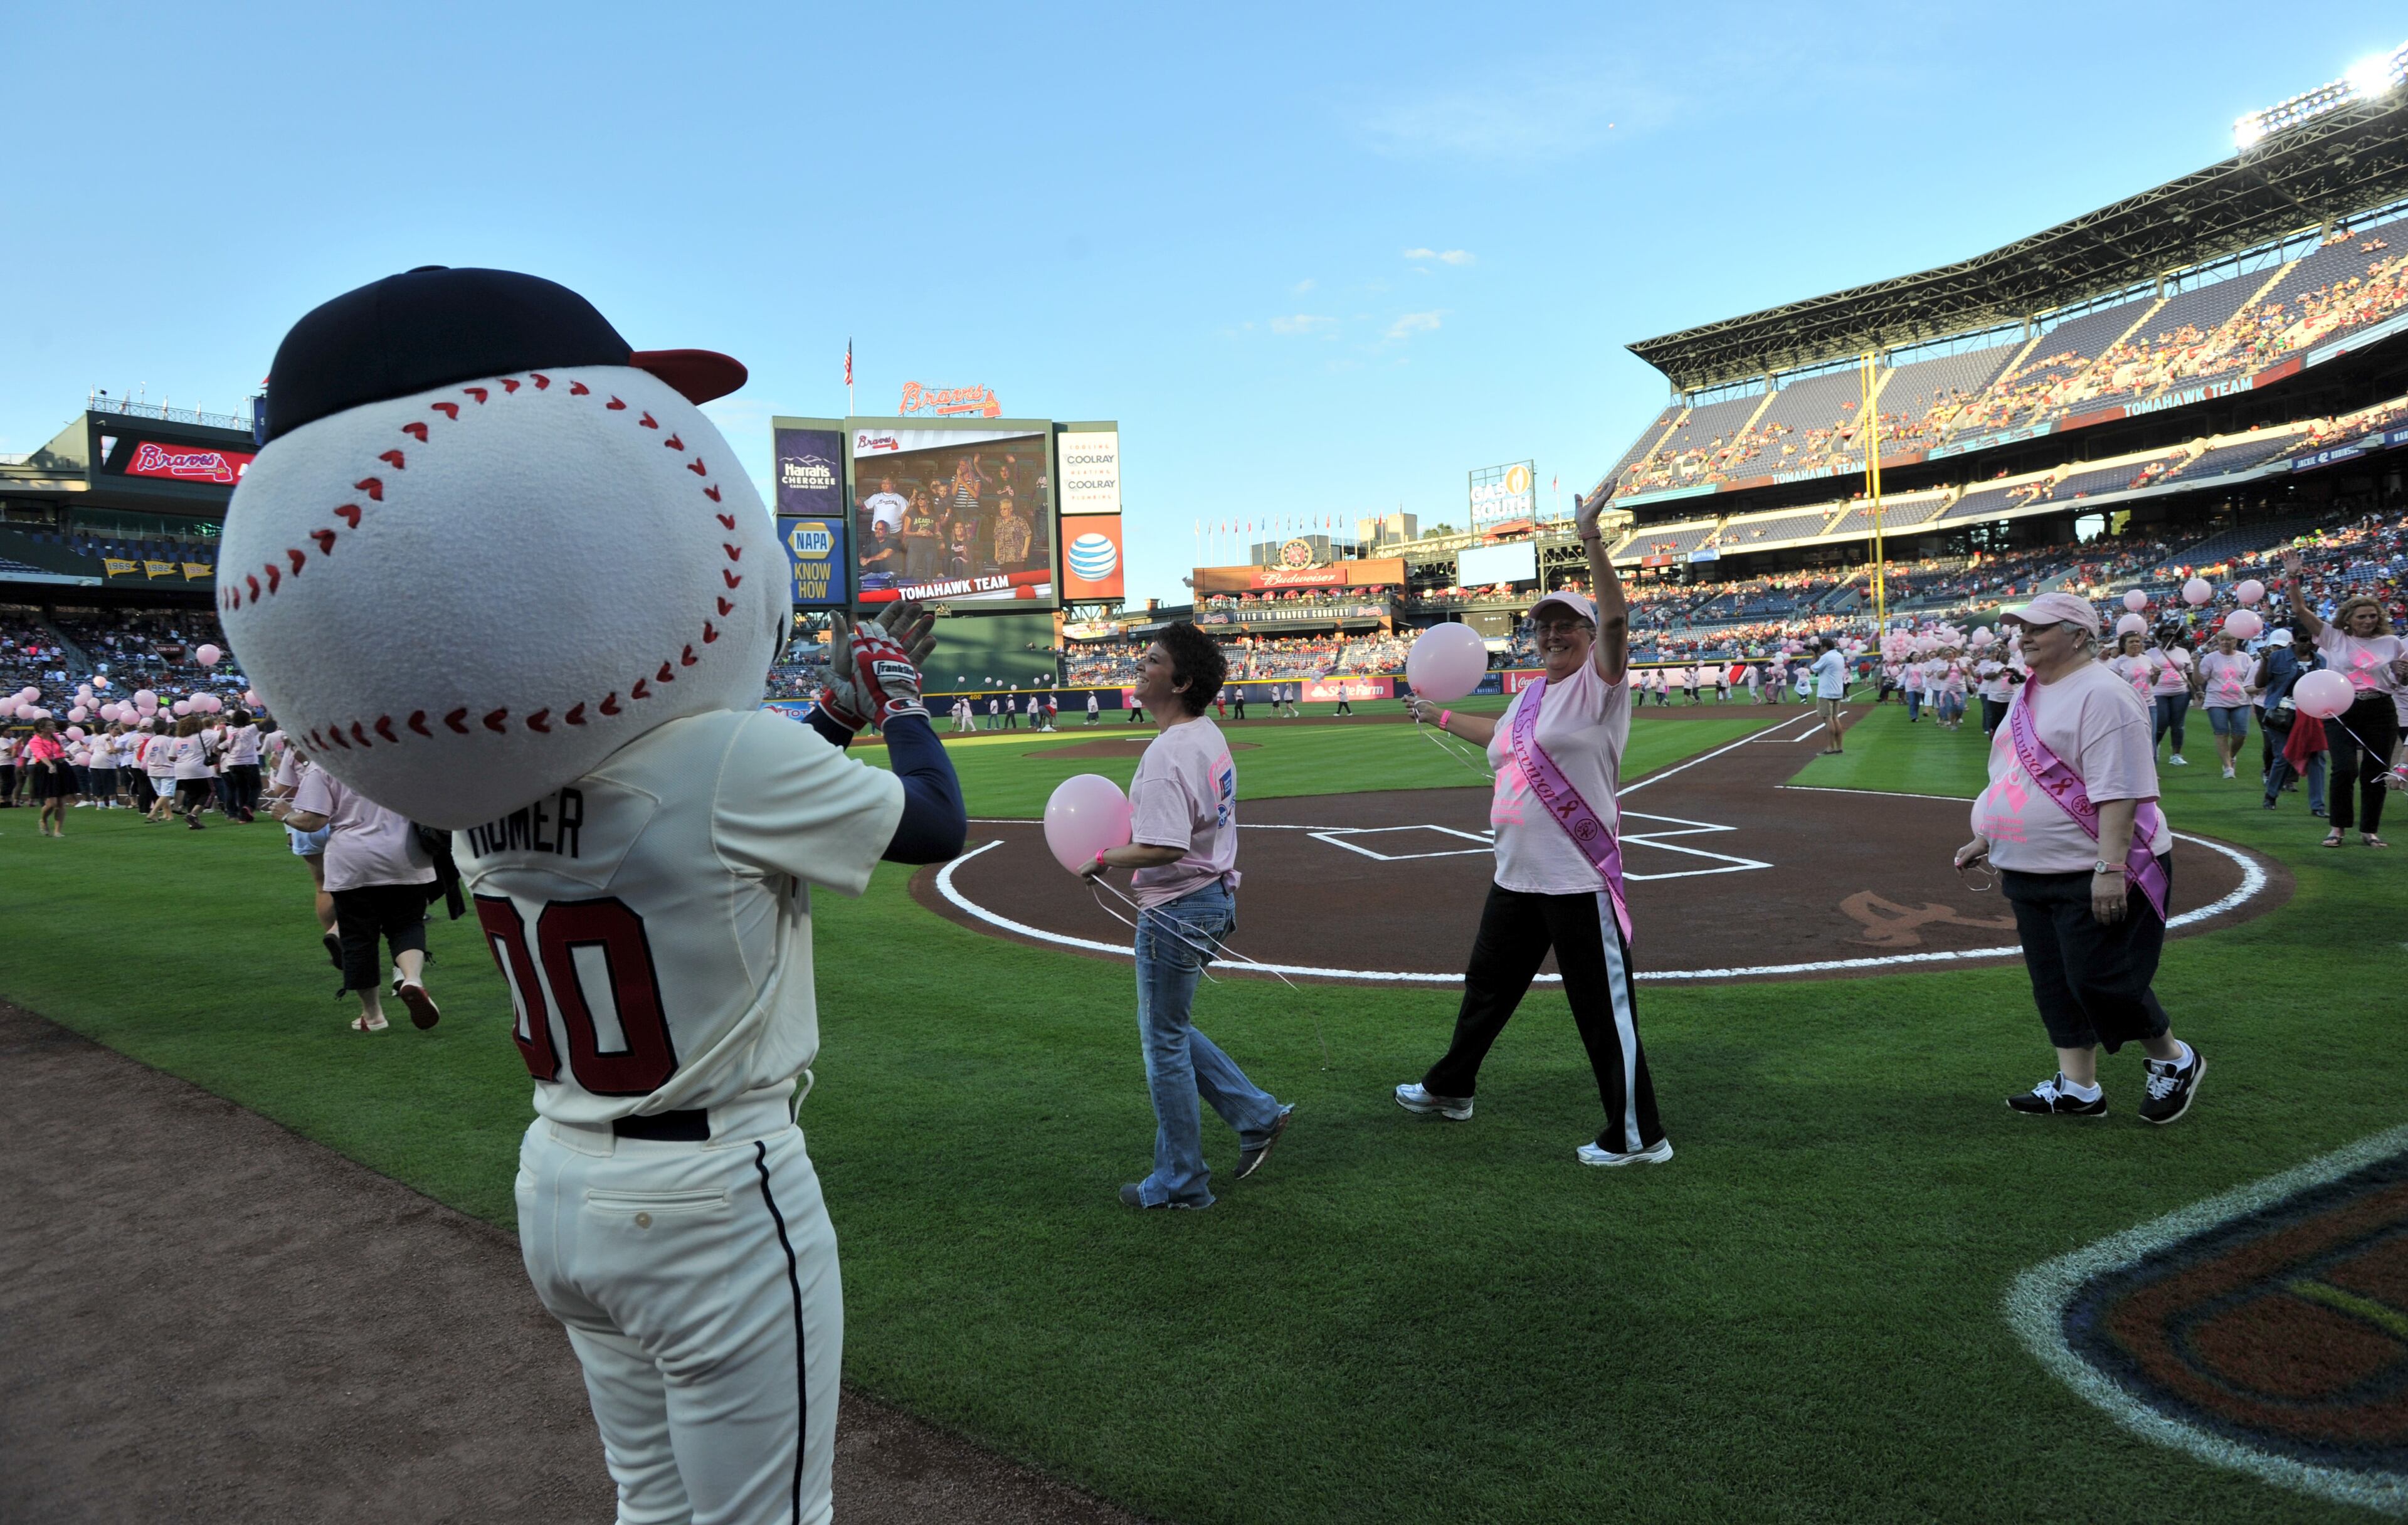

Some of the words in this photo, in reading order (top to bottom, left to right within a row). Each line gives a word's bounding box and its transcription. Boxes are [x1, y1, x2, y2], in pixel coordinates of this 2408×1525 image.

[899, 381, 984, 416] Braves
[2123, 388, 2207, 417] TOMAHAWK
[2210, 376, 2253, 398] TEAM
[857, 435, 891, 449] Braves
[137, 443, 221, 472] Braves
[1067, 455, 1114, 464] COOLRAY
[2318, 452, 2329, 463] 42
[784, 463, 830, 477] Harrah's
[1772, 466, 1834, 485] TOMAHAWK
[1836, 461, 1867, 475] TEAM
[781, 477, 836, 485] CHEROKEE
[1068, 480, 1116, 489] COOLRAY
[1471, 482, 1506, 503] GAS
[1472, 496, 1531, 520] SOUTH
[796, 532, 827, 549] NAPA
[108, 562, 131, 571] 1969
[795, 562, 831, 580] KNOW
[1260, 572, 1336, 586] Budweiser
[798, 581, 827, 598] HOW
[899, 579, 971, 601] TOMAHAWK
[974, 575, 1009, 591] TEAM
[1262, 612, 1272, 620] IS
[1276, 611, 1307, 620] BRAVES
[1312, 608, 1349, 618] COUNTRY
[877, 662, 915, 676] Franklin
[1355, 684, 1383, 695] Farm
[2012, 705, 2053, 779] Survivor
[1514, 718, 1560, 801] Survivor
